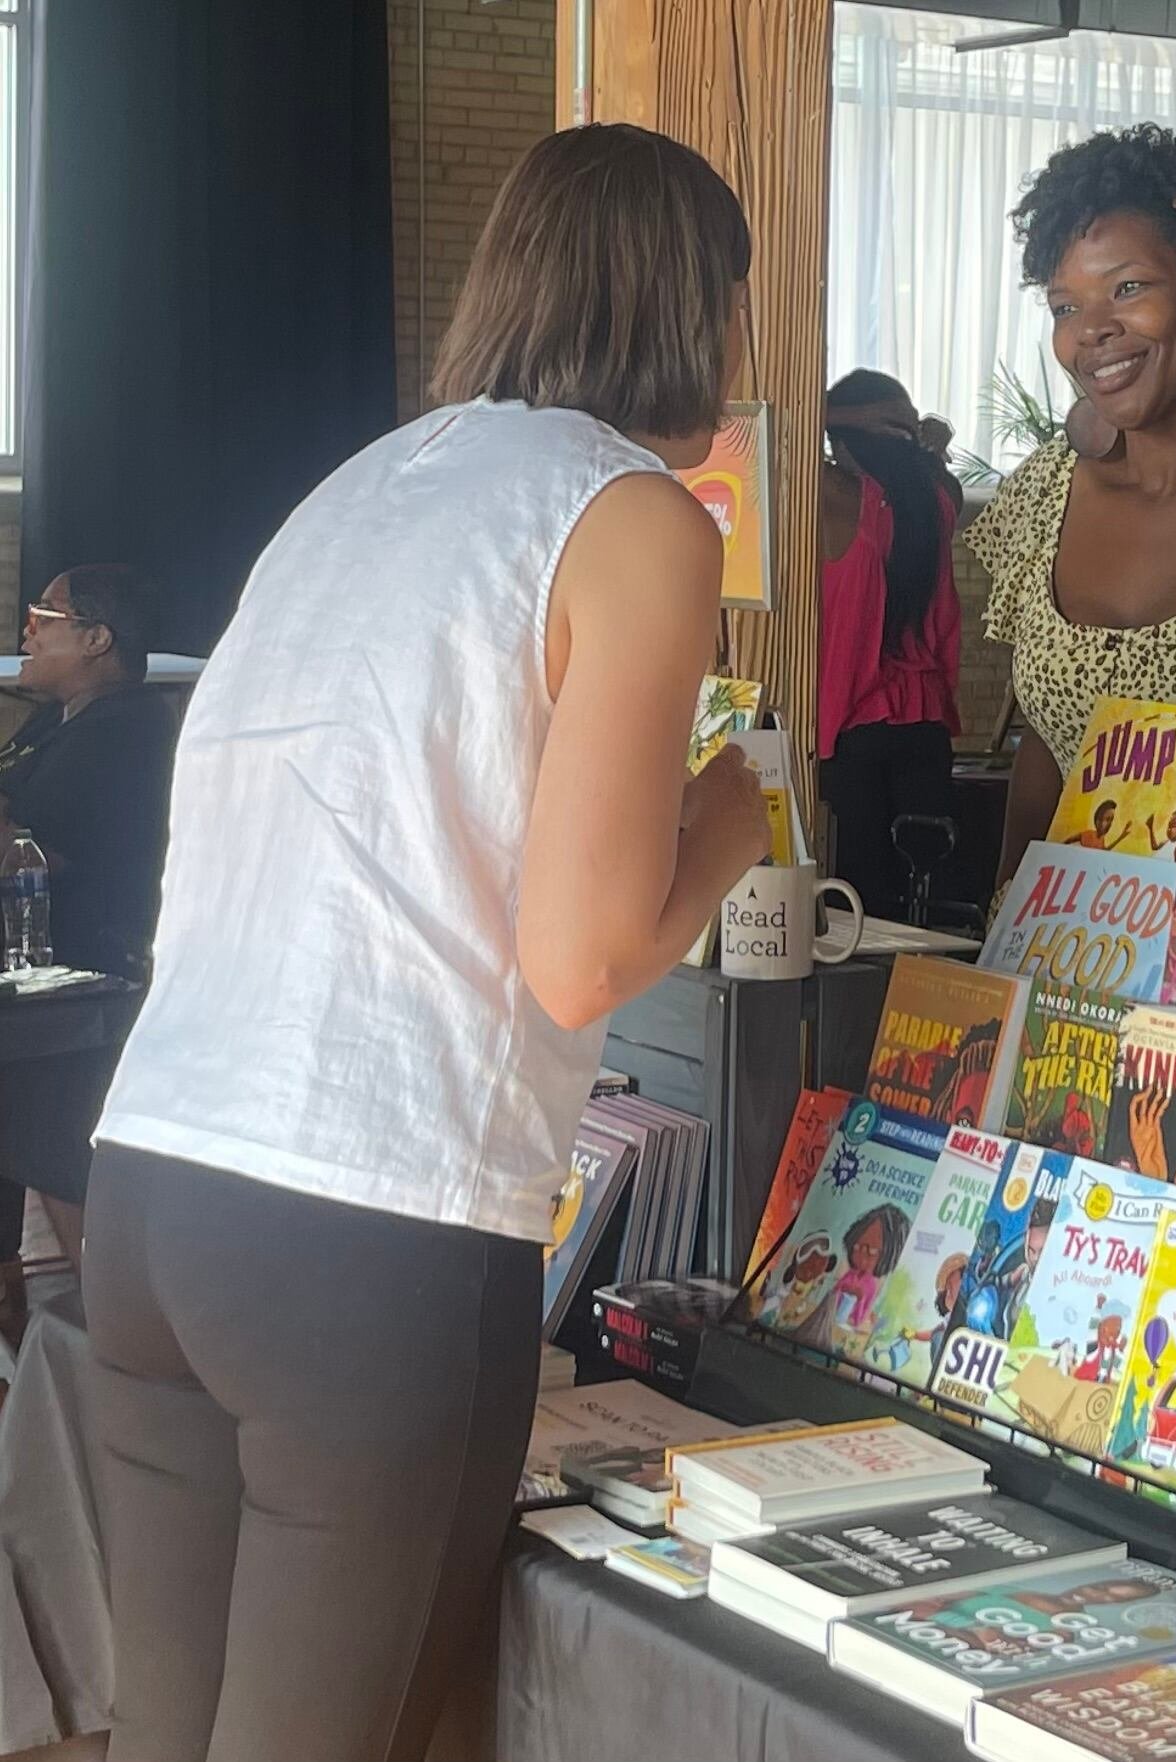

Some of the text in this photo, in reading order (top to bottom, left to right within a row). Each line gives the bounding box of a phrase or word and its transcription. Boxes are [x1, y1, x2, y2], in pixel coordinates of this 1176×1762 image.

[1082, 720, 1176, 793] JUMP
[727, 902, 787, 928] Read
[1013, 865, 1173, 939] ALL GOOD
[725, 930, 788, 957] Local
[1011, 930, 1027, 943] IN
[1017, 922, 1137, 991] HOOD
[1036, 992, 1075, 1013] NNEDI
[884, 1010, 963, 1050] PARABLE
[876, 1047, 900, 1079] OF
[1023, 1053, 1113, 1107] THE RA
[870, 1082, 933, 1118] SOWER
[855, 1113, 870, 1133] 2
[880, 1120, 901, 1135] STEP
[865, 1159, 925, 1188] DO A SCIENCE
[949, 1174, 991, 1198] PARKER
[868, 1179, 924, 1205] EXPERIMEN
[1115, 1200, 1121, 1216] I
[1123, 1201, 1149, 1218] Can
[1063, 1225, 1101, 1265] TY'S
[938, 1377, 988, 1407] DEFENDER
[917, 1529, 966, 1550] TO
[927, 1505, 1049, 1559] WAITING
[842, 1525, 951, 1573] INHALE
[875, 1610, 1021, 1675] Money
[975, 1607, 1105, 1663] Good
[1050, 1612, 1139, 1652] Get
